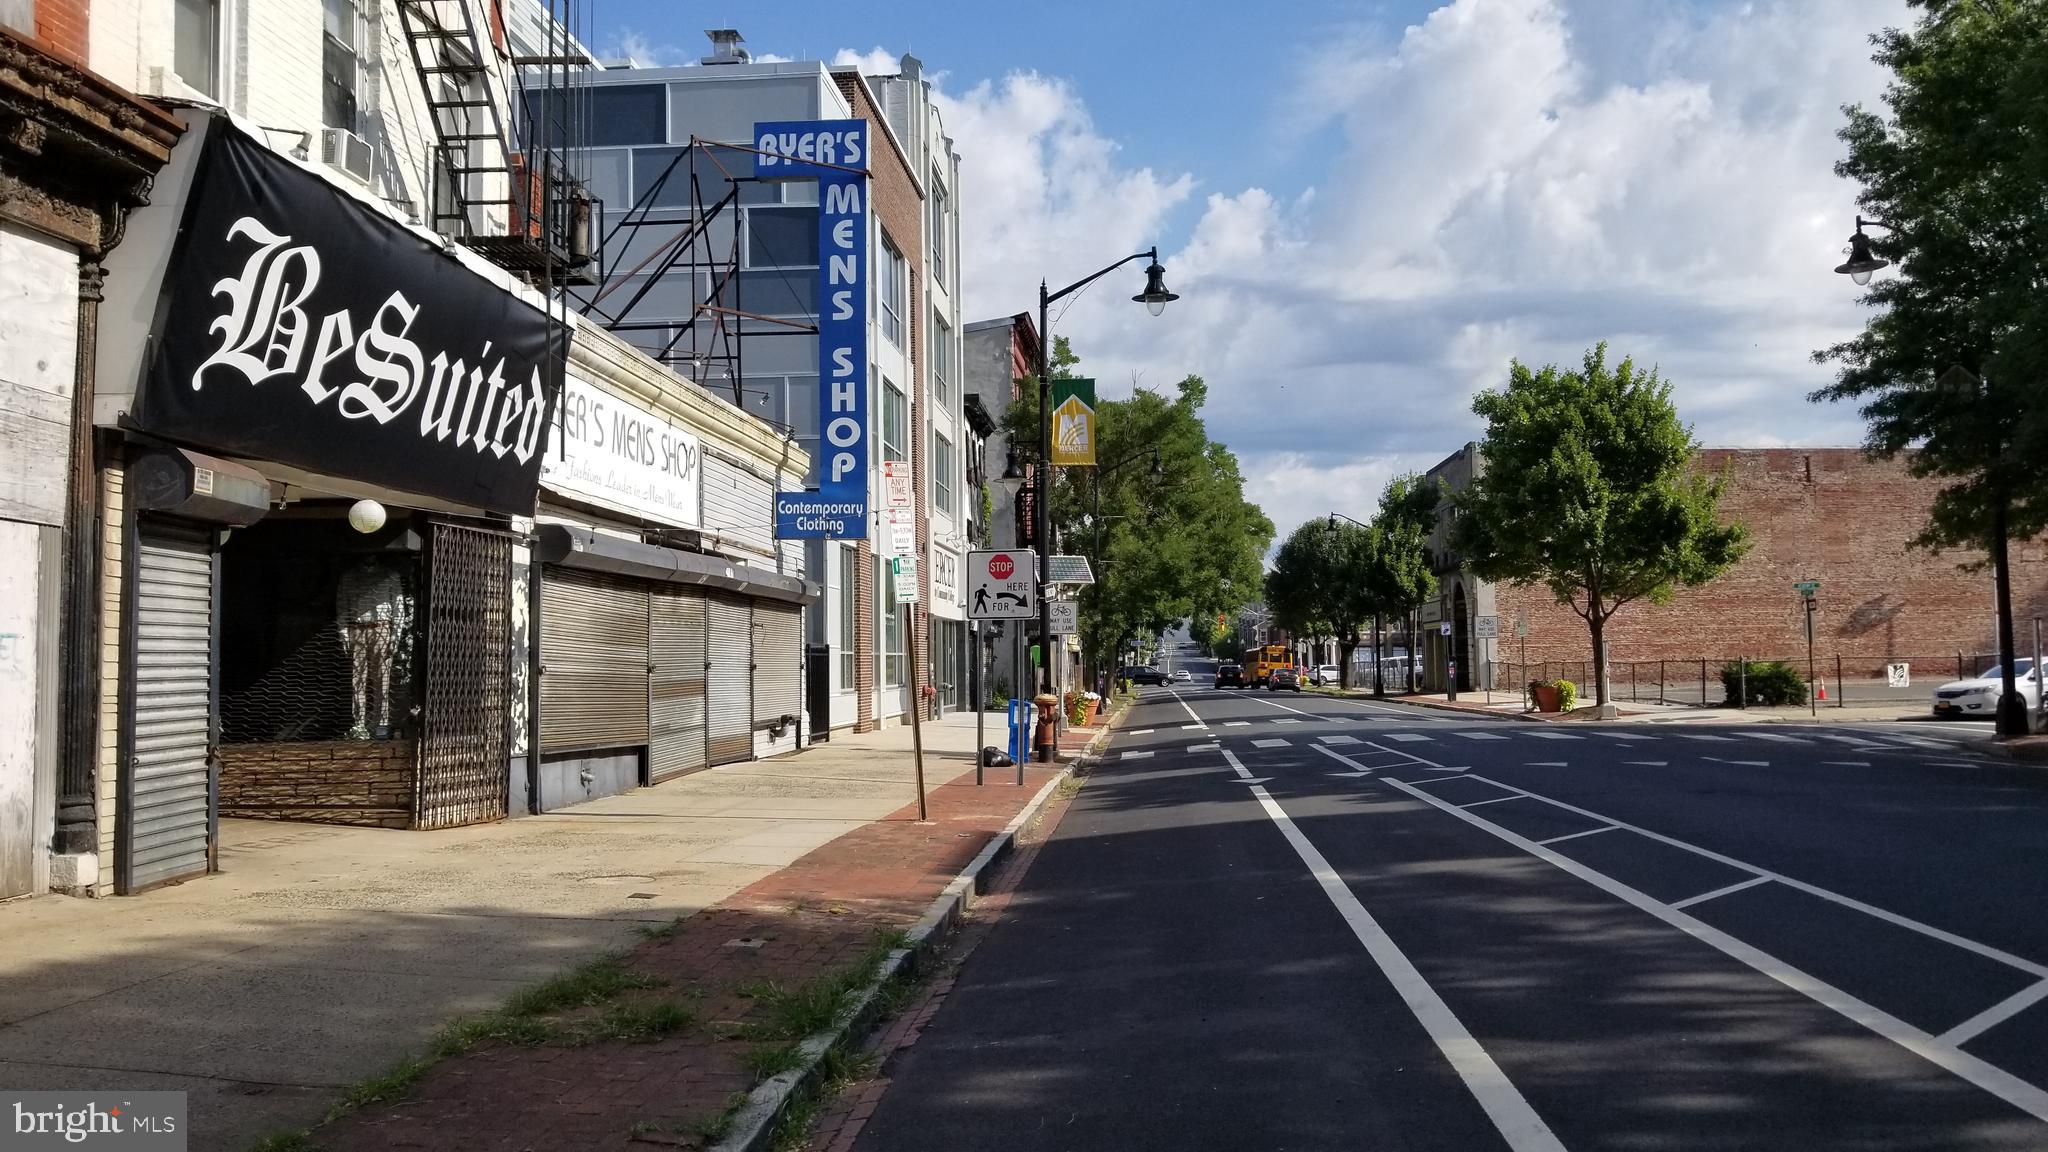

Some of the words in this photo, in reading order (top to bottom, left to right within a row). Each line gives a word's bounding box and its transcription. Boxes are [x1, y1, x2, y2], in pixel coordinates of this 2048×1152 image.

[758, 131, 861, 166] BYER'S
[825, 183, 861, 321] MENS
[192, 216, 546, 466] BeSuited
[826, 347, 861, 483] SHOP
[612, 410, 655, 466] MENS
[661, 433, 697, 482] SHOP
[566, 454, 602, 486] Fashions
[605, 470, 632, 494] Leader
[891, 478, 905, 487] ANY
[891, 486, 907, 495] TIME
[778, 500, 863, 518] Contemporary
[796, 516, 844, 534] Clothing
[989, 562, 1013, 572] STOP
[1006, 582, 1029, 591] HERE
[992, 602, 1010, 611] FOR
